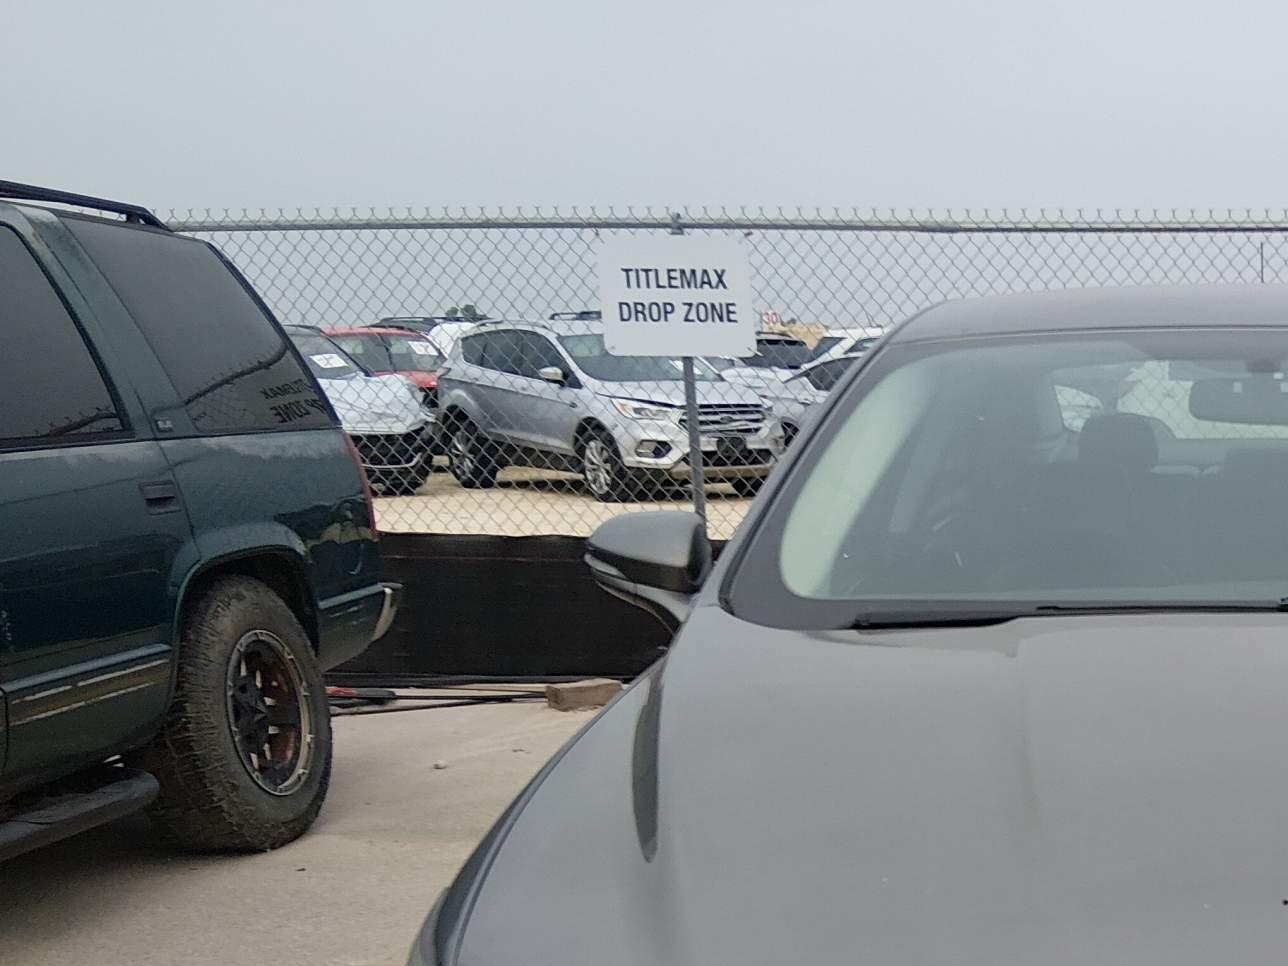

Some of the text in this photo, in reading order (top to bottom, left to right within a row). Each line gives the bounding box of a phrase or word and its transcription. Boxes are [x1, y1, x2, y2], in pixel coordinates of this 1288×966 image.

[620, 268, 728, 290] TITLEMAX
[618, 301, 738, 323] DROP ZONE
